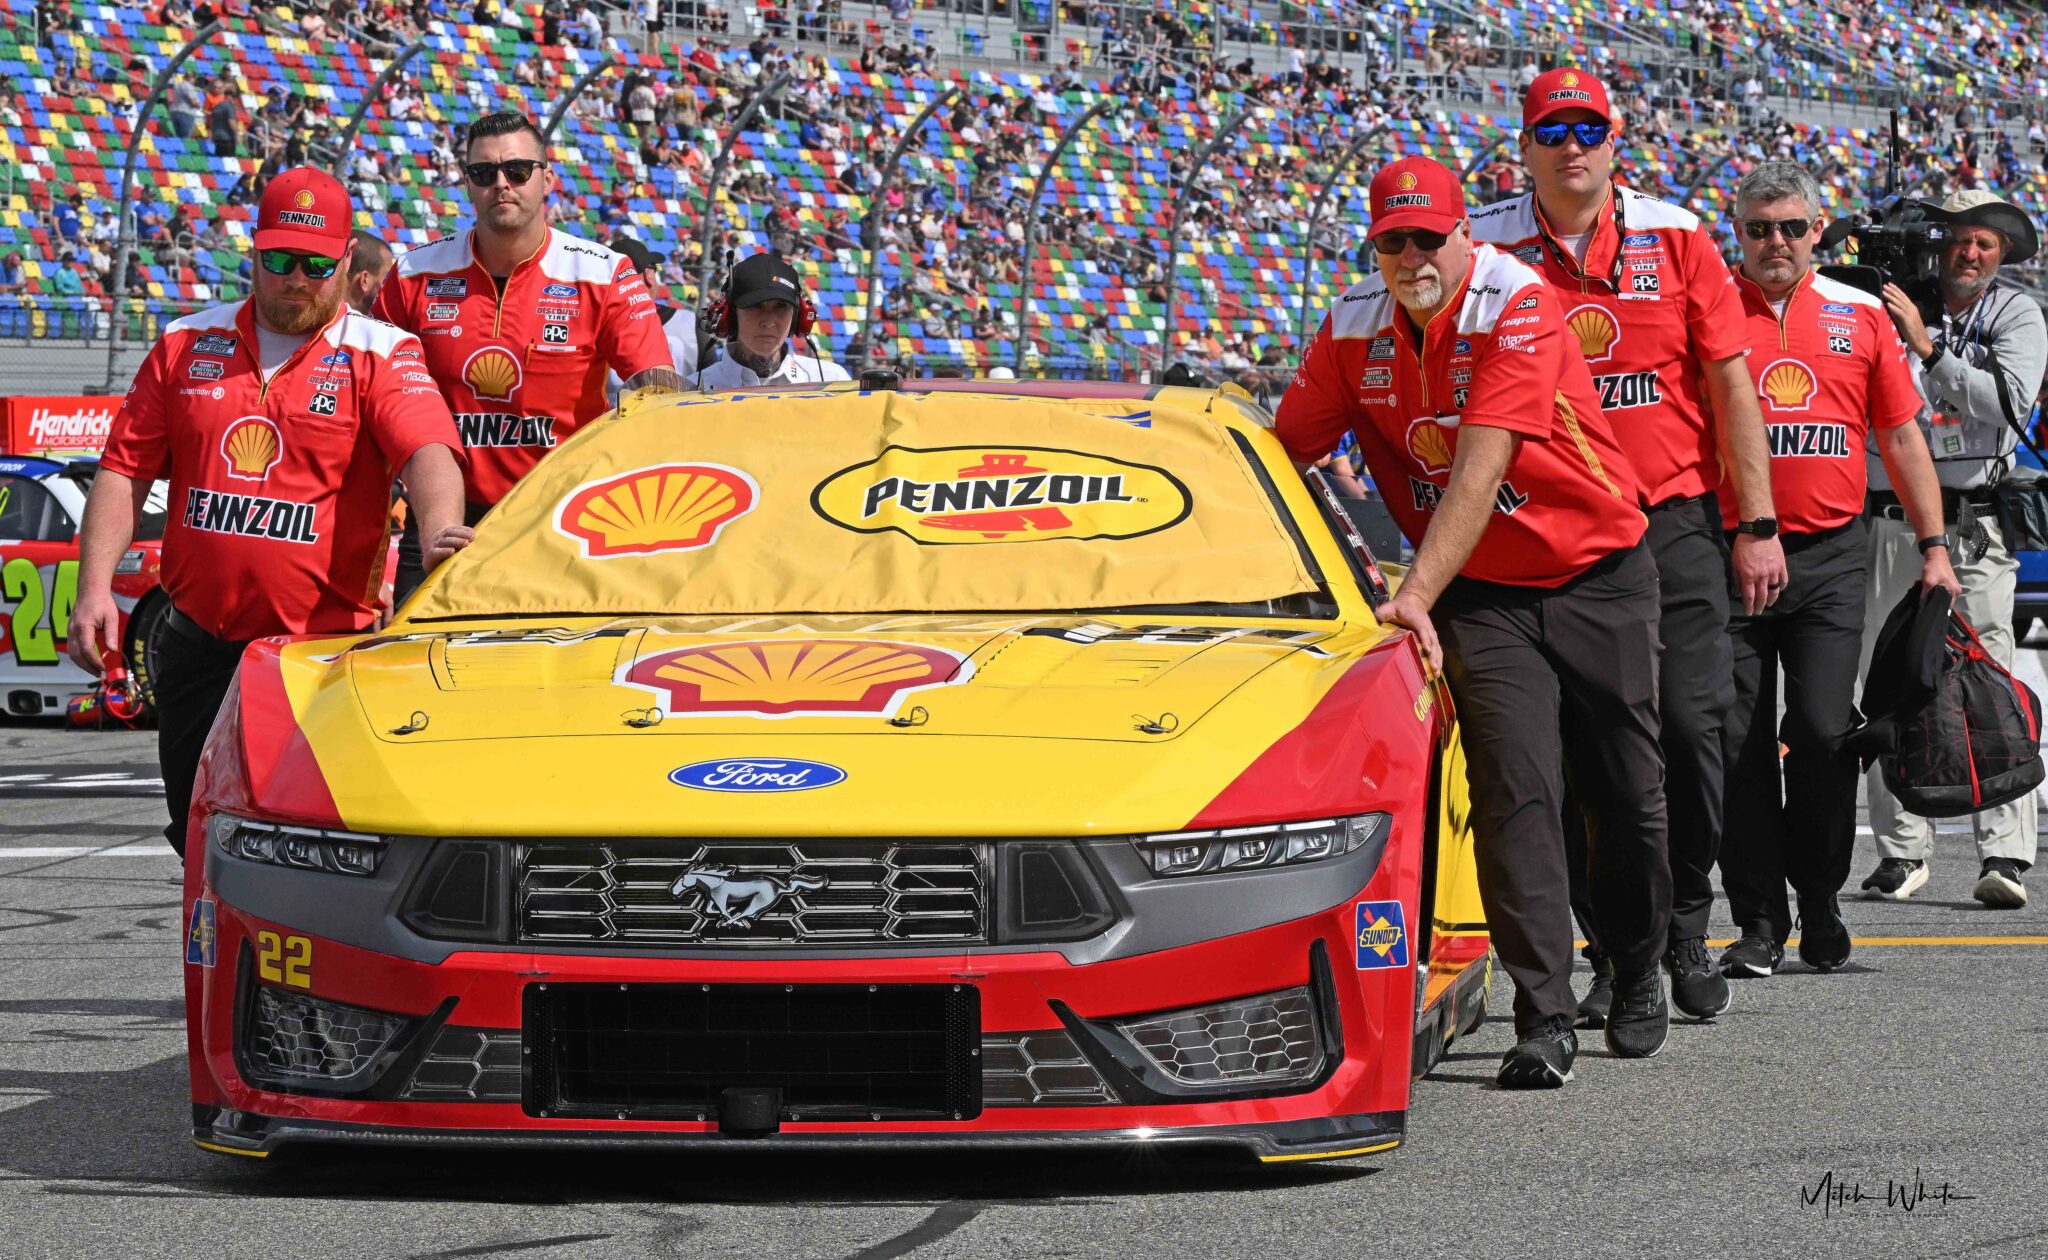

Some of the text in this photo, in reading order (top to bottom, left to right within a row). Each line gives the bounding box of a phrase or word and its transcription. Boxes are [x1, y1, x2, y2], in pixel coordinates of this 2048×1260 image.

[1548, 90, 1592, 103] PENNZOIL
[1384, 193, 1432, 210] PENNZOIL
[278, 210, 326, 228] PENNZOIL
[1630, 235, 1653, 246] Ford
[550, 285, 572, 296] Ford
[1634, 275, 1657, 291] PPG
[536, 306, 580, 317] DISCOUNT
[1827, 304, 1850, 314] Ford
[1500, 316, 1540, 328] nap-on
[544, 325, 568, 342] PPG
[1830, 337, 1851, 352] PPG
[309, 393, 335, 413] PPG
[28, 409, 113, 445] Hendrick
[860, 473, 1134, 520] PENNZOIL
[183, 487, 320, 545] PENNZOIL
[703, 762, 812, 786] Ford
[1361, 928, 1399, 946] SUNOCO
[258, 930, 312, 989] 22
